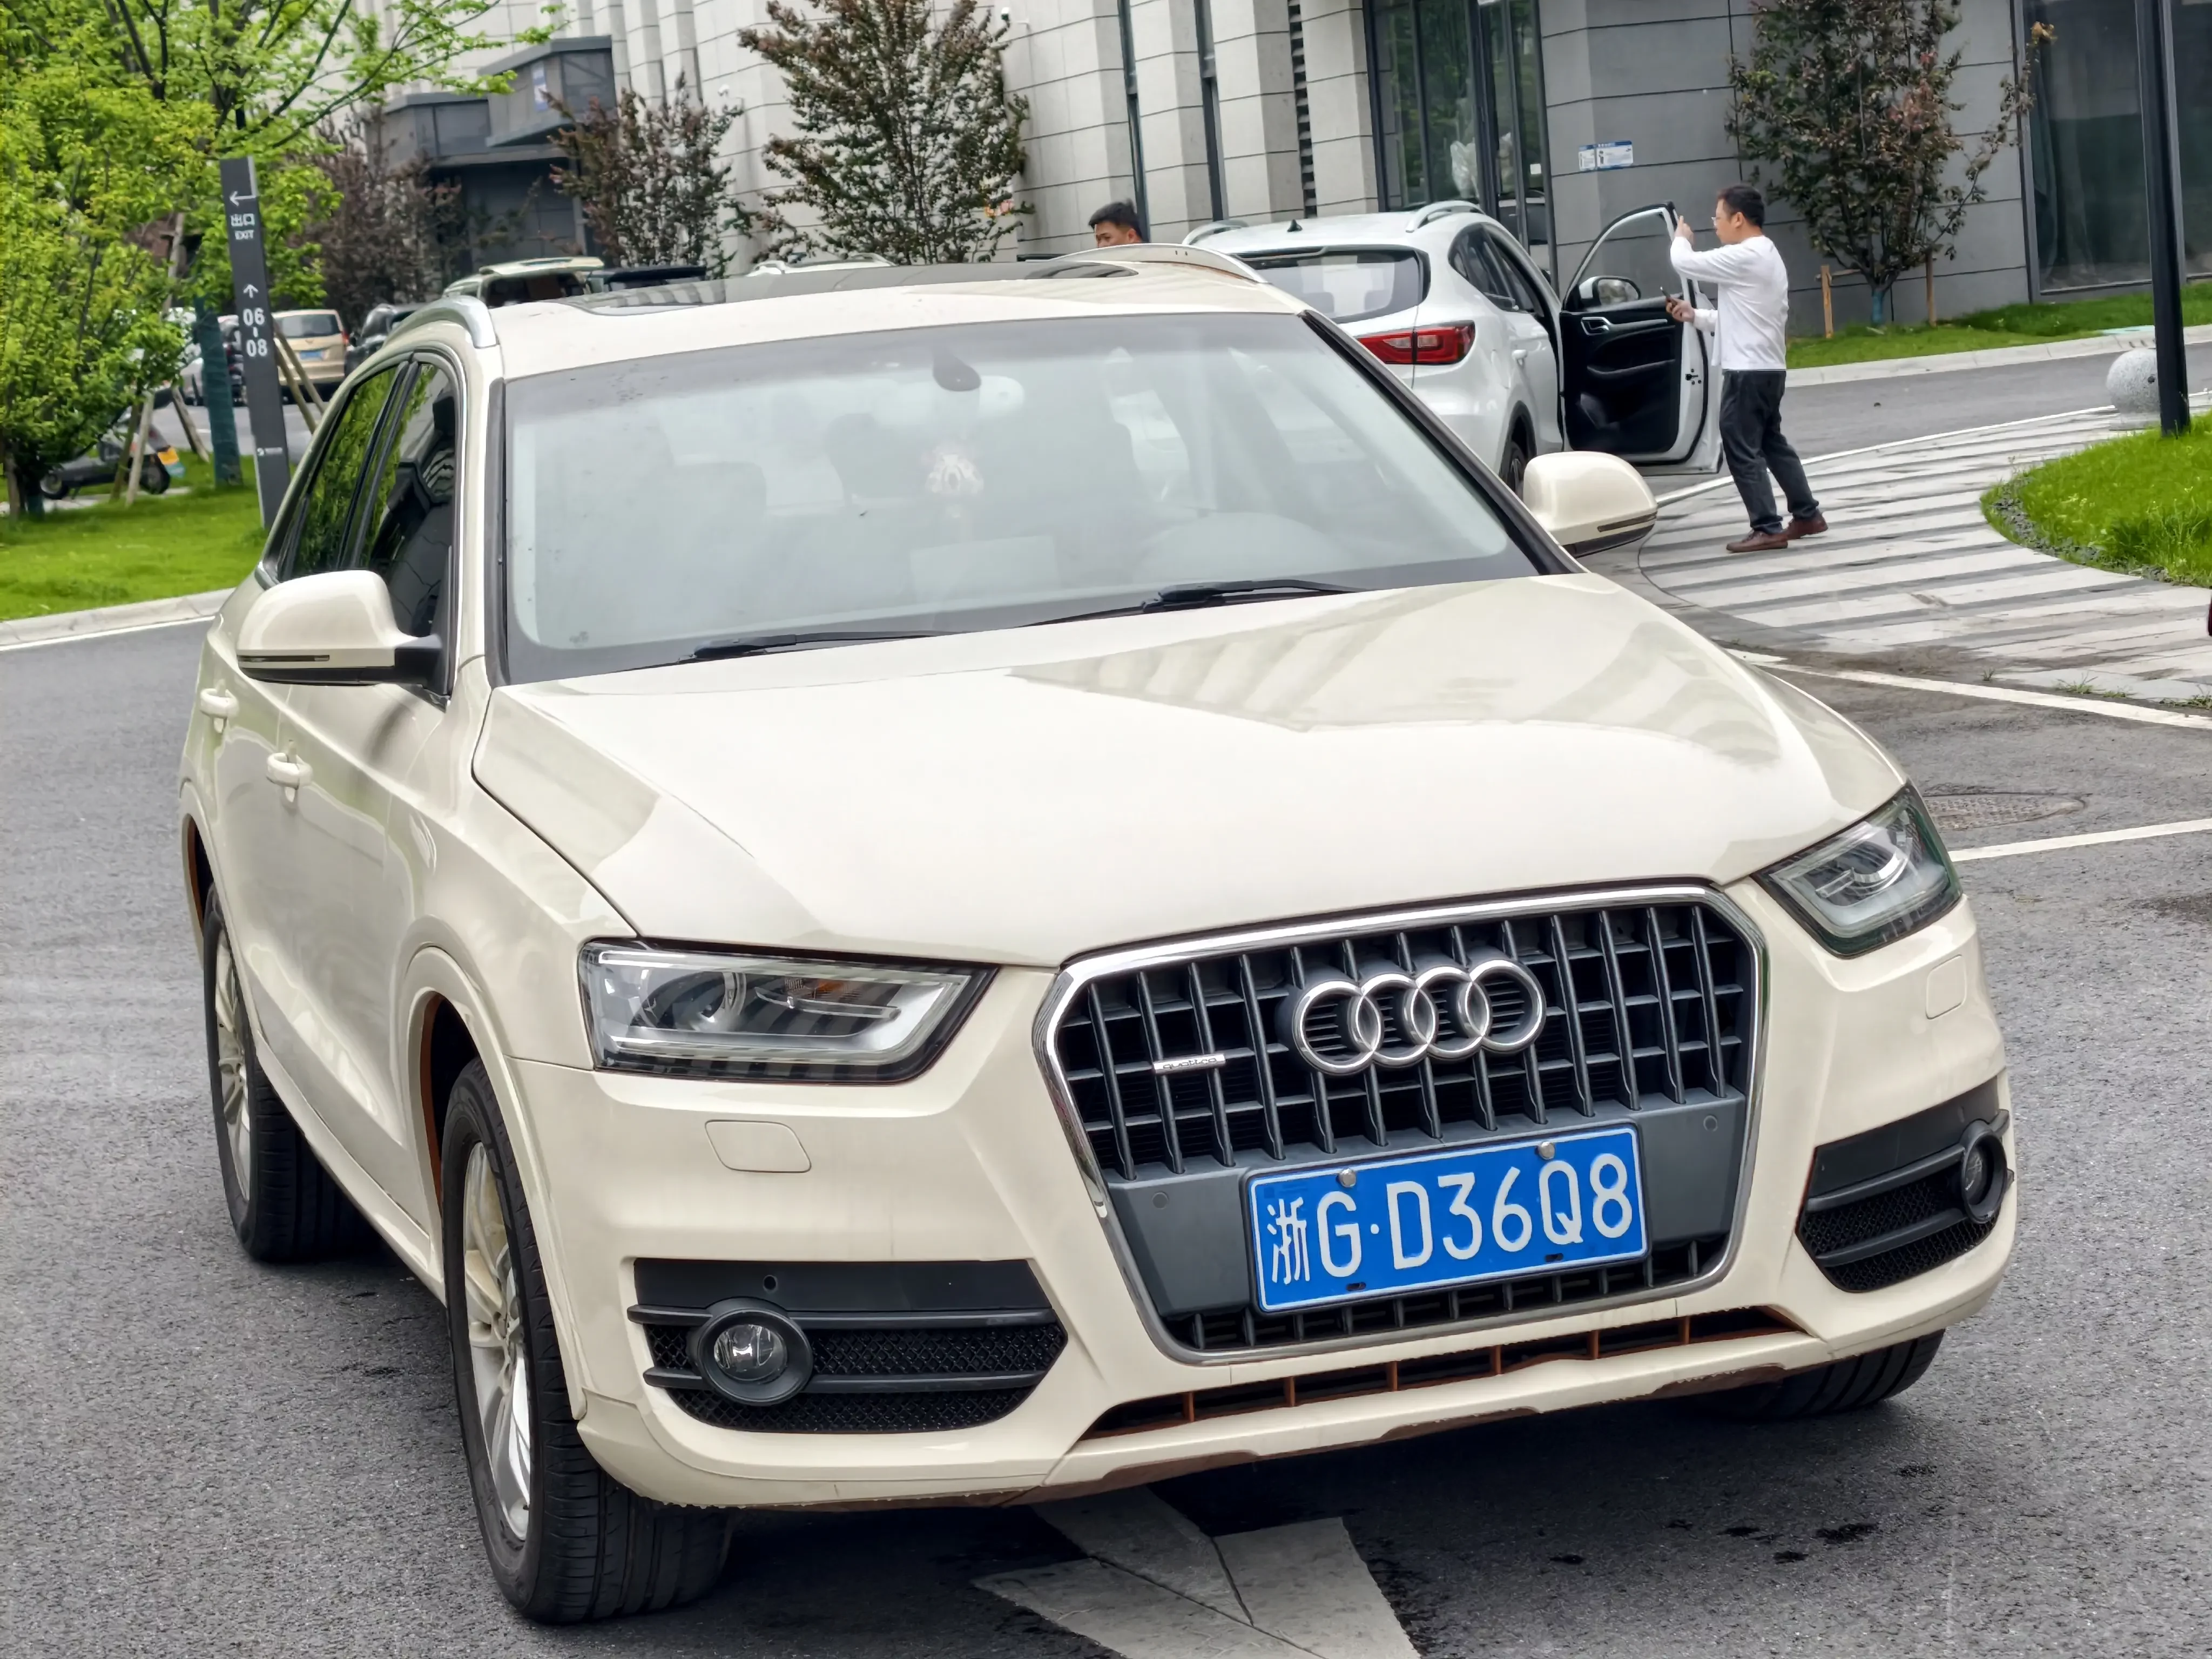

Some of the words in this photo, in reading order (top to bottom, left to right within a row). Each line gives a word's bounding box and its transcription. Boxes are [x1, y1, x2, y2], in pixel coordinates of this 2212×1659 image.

[231, 213, 255, 227] 出口
[242, 307, 265, 326] 06
[246, 338, 268, 357] 08
[1162, 1057, 1217, 1069] quattro
[1266, 1152, 1633, 1285] 浙G·D36Q8
